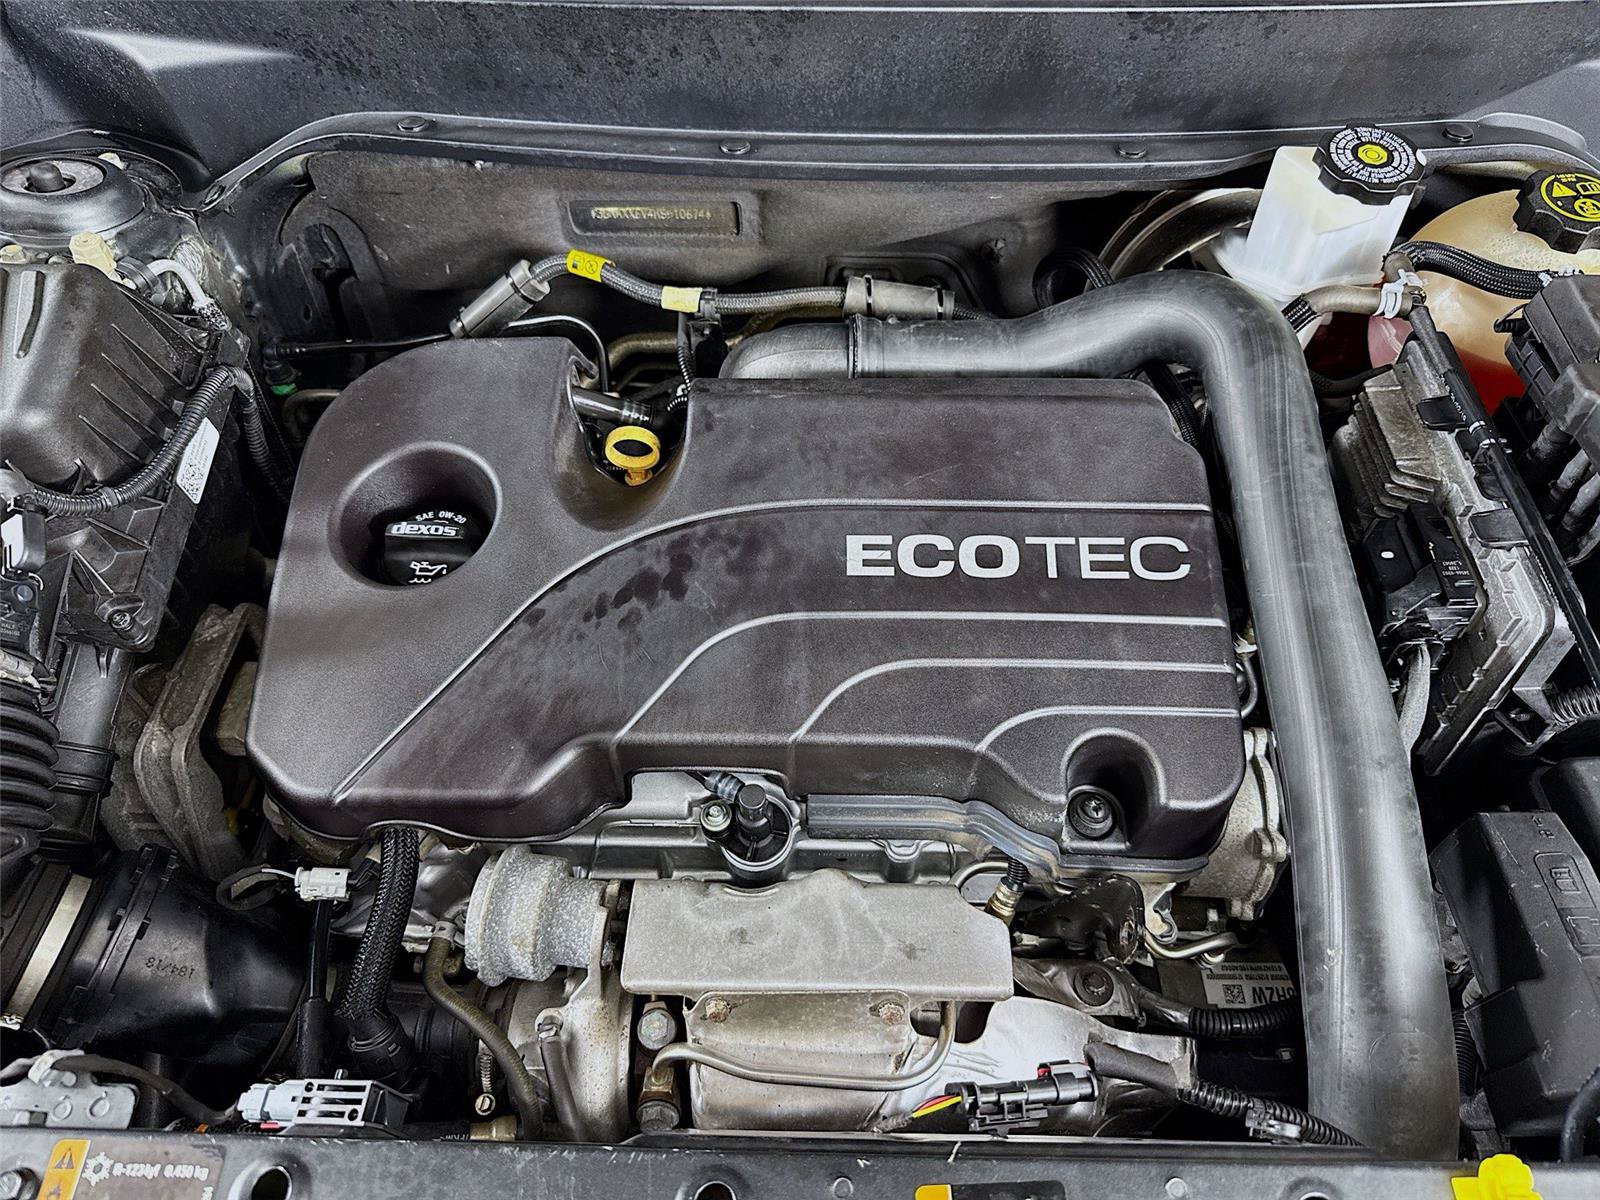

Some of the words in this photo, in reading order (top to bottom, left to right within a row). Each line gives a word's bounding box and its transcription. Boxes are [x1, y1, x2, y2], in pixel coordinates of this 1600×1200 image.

[415, 511, 435, 522] SAE
[390, 521, 460, 537] dexos
[845, 534, 1192, 580] ECOTEC
